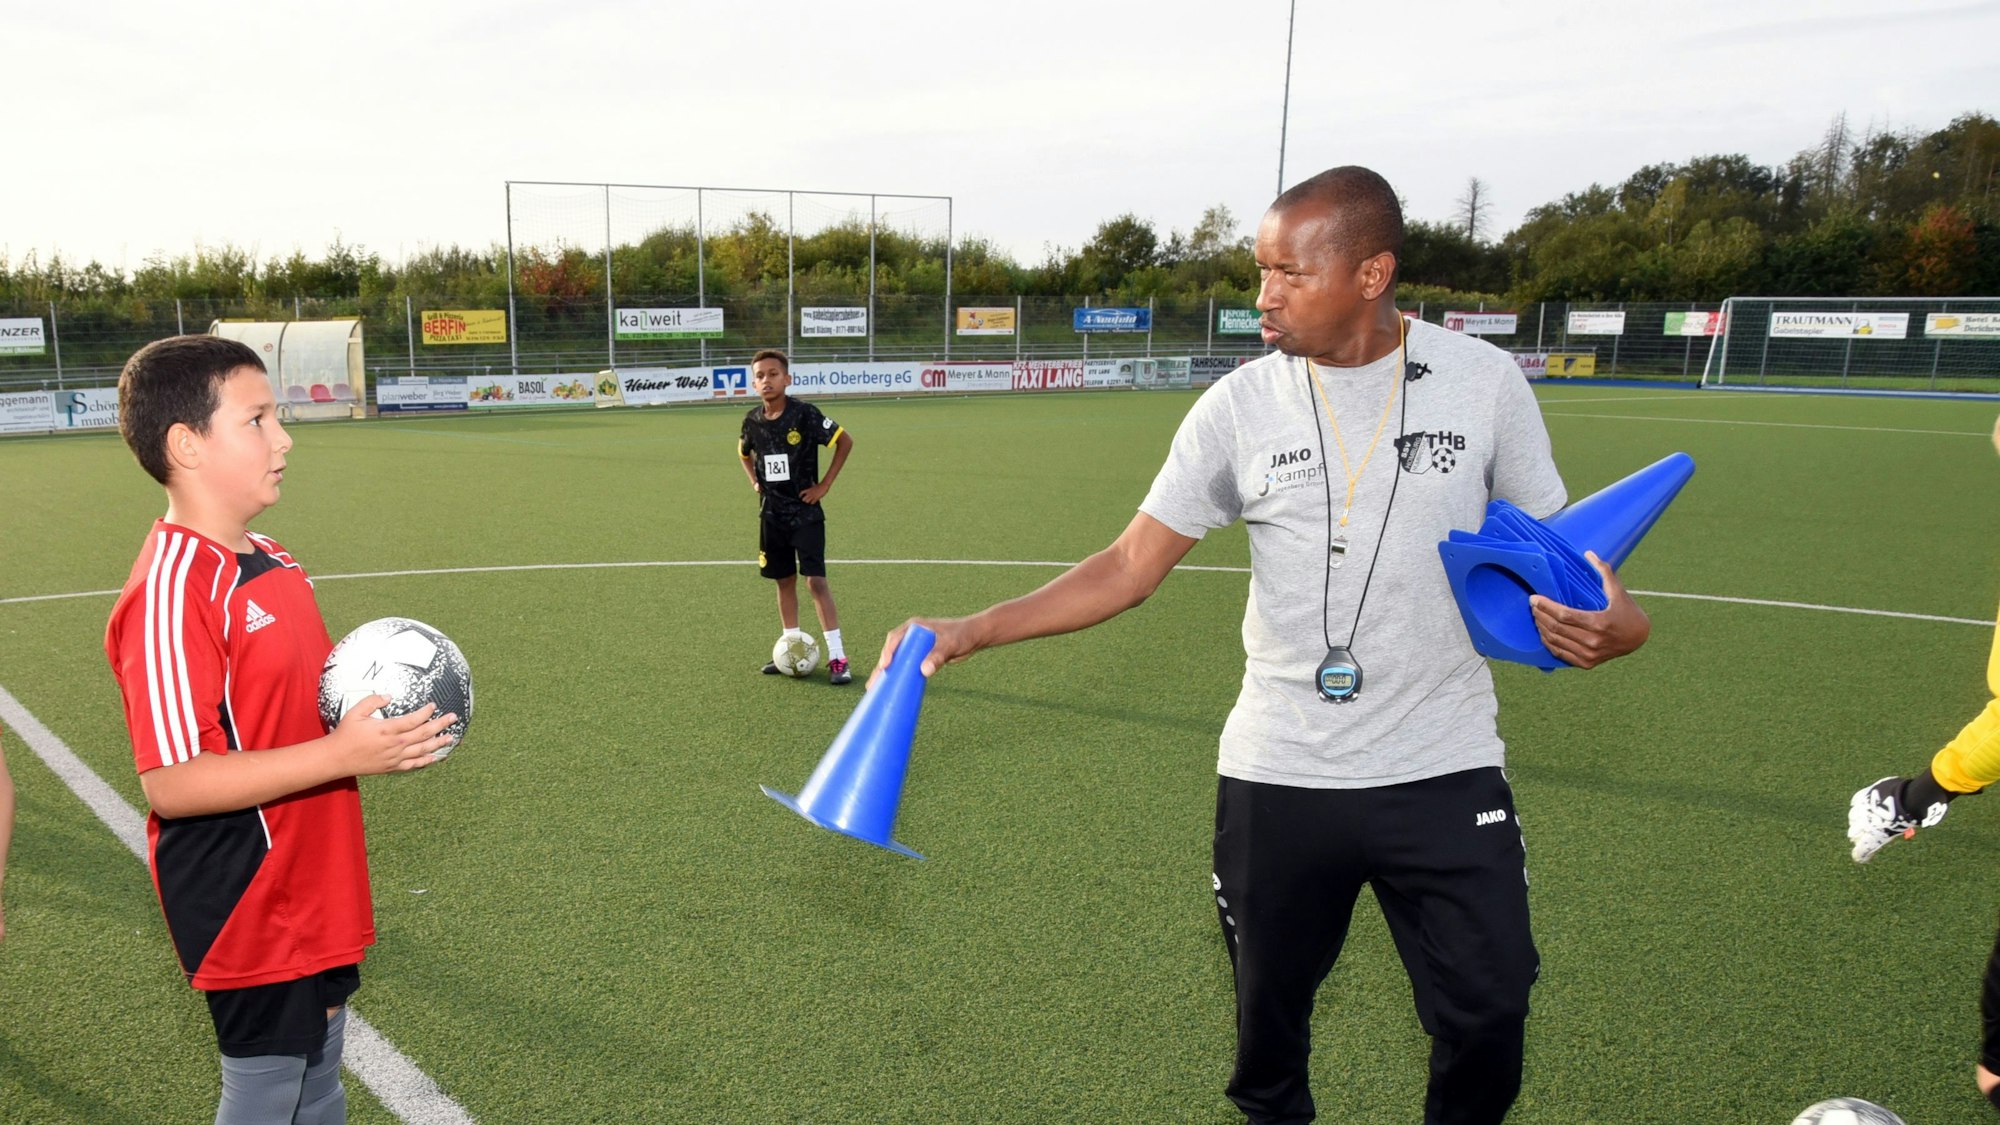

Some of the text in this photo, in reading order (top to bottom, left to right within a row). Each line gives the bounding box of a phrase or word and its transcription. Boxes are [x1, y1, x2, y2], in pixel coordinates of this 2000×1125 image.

[424, 319, 466, 335] BERFIN
[1775, 316, 1852, 325] TRAUTMANN
[0, 328, 40, 336] NZER
[1192, 357, 1236, 368] FAHRSCHULE
[829, 370, 892, 388] Oberberg
[894, 370, 912, 384] eG
[948, 369, 976, 381] Meyer
[977, 369, 983, 379] &
[985, 369, 1009, 379] Mann
[1013, 368, 1083, 389] TAXI LANG
[518, 381, 546, 394] BASOL
[625, 376, 709, 393] Heiner Weiß
[1424, 430, 1466, 450] THB
[1270, 448, 1312, 469] JAKO
[767, 460, 787, 475] 1&1
[245, 613, 276, 633] adidas
[1475, 809, 1507, 826] JAKO
